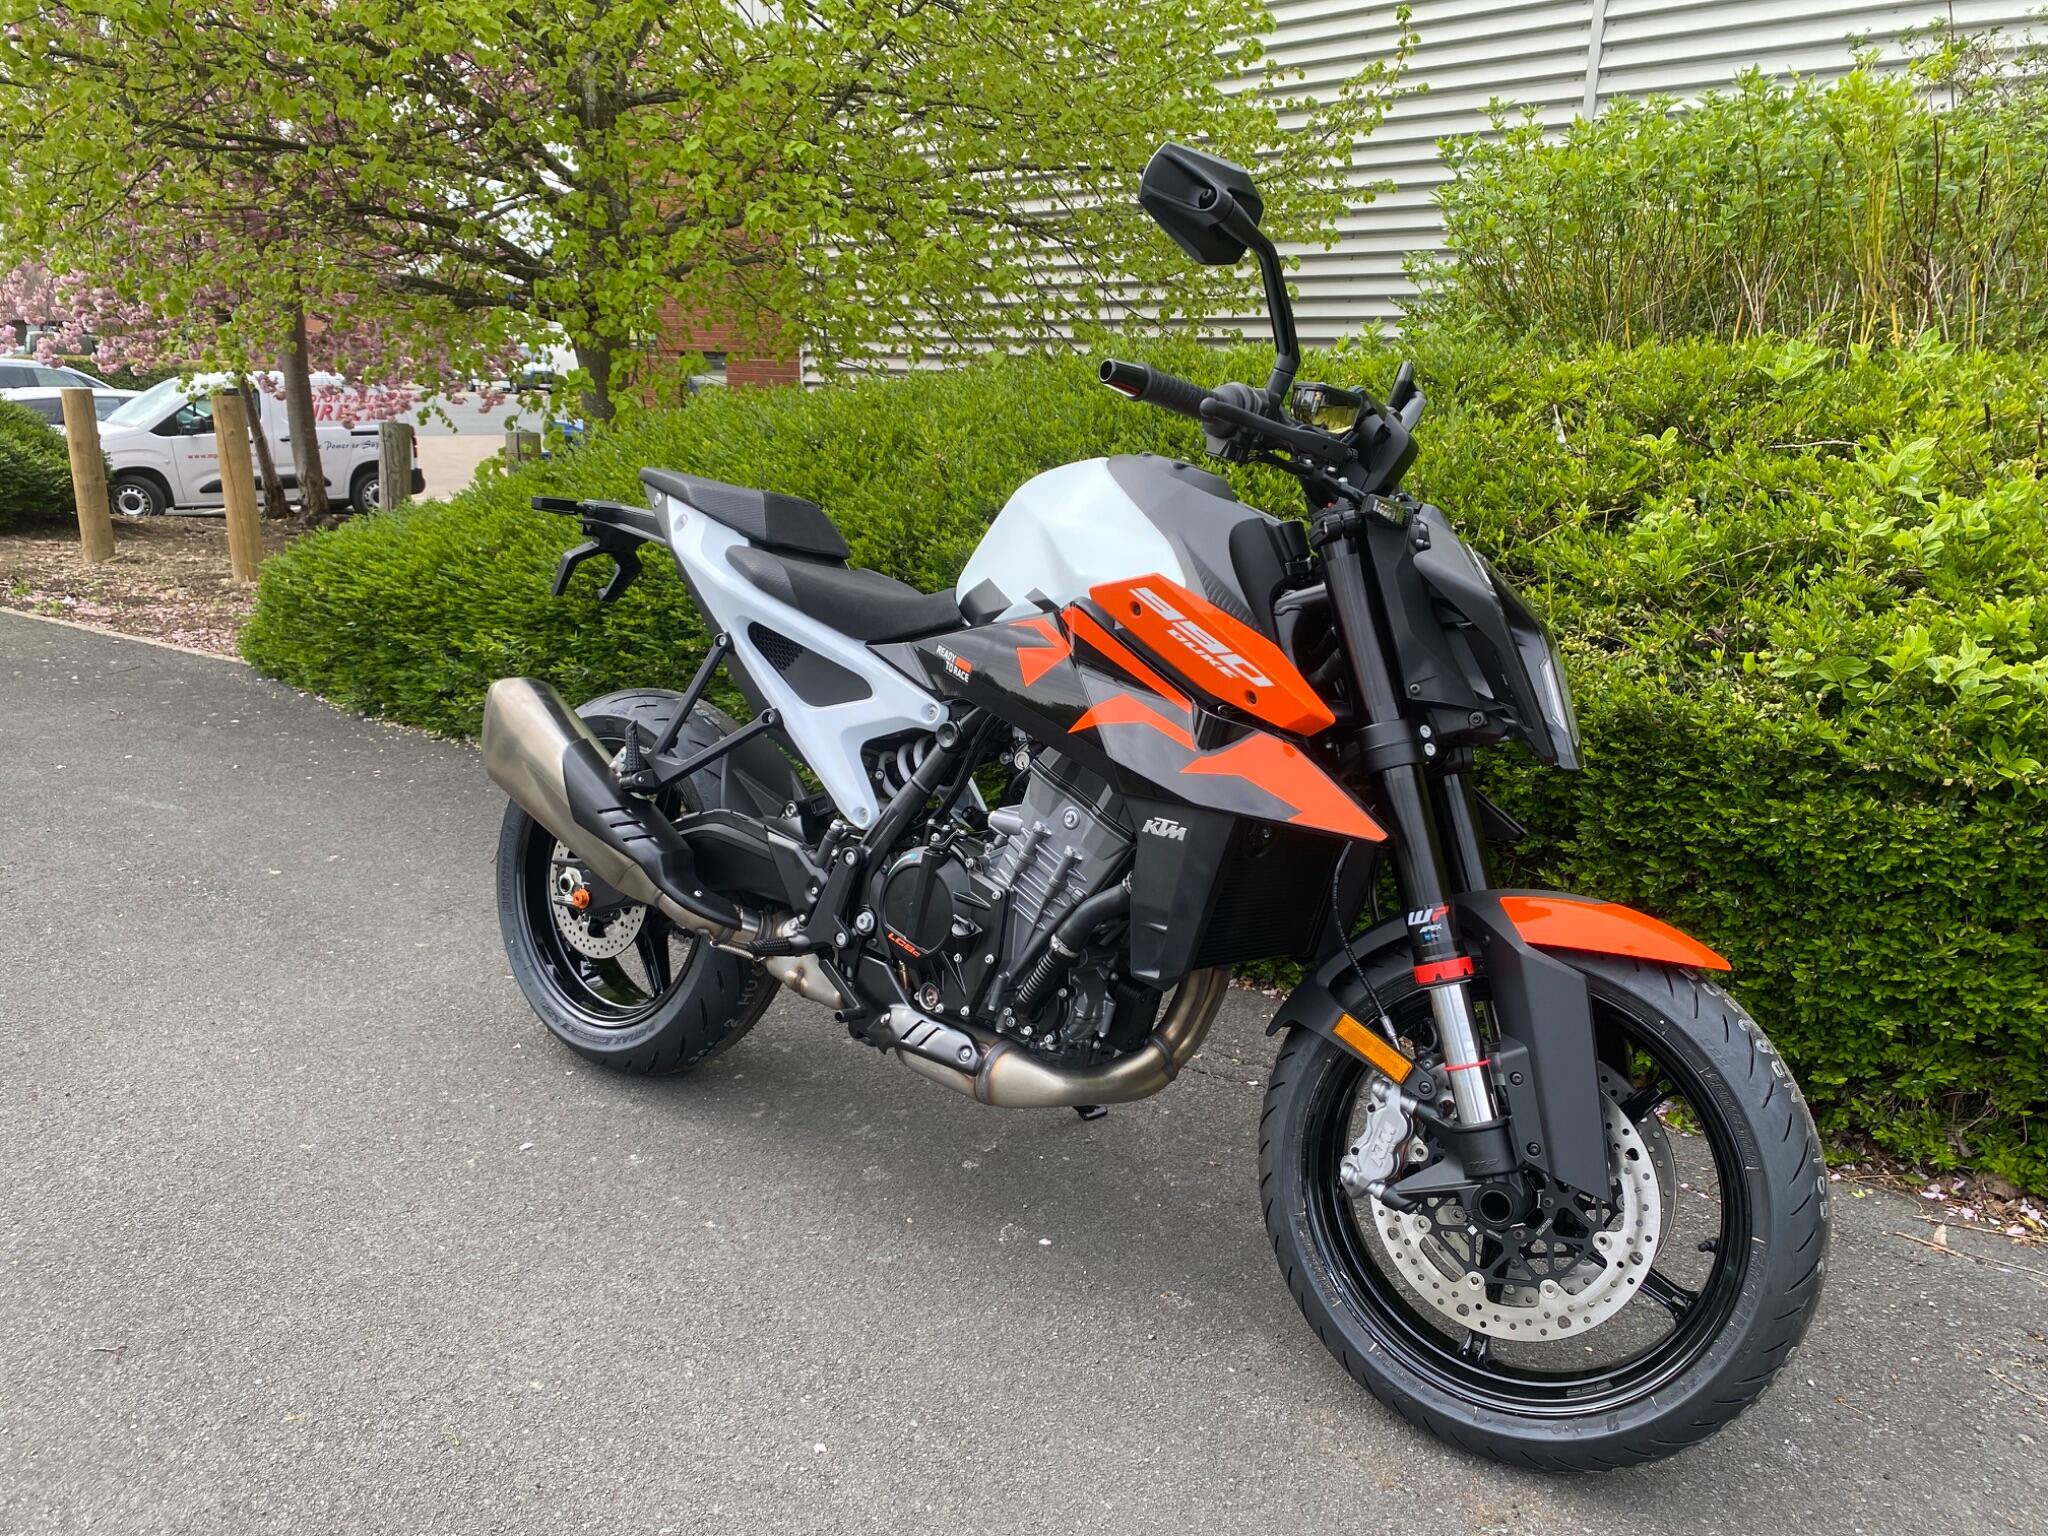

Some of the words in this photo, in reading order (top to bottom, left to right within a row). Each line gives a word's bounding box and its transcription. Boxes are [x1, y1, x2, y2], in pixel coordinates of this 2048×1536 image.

[936, 644, 957, 663] READY
[1166, 629, 1239, 679] DUKE
[945, 660, 954, 673] TO
[953, 666, 970, 683] RACE
[1141, 816, 1188, 841] KTM
[1407, 905, 1450, 926] WP
